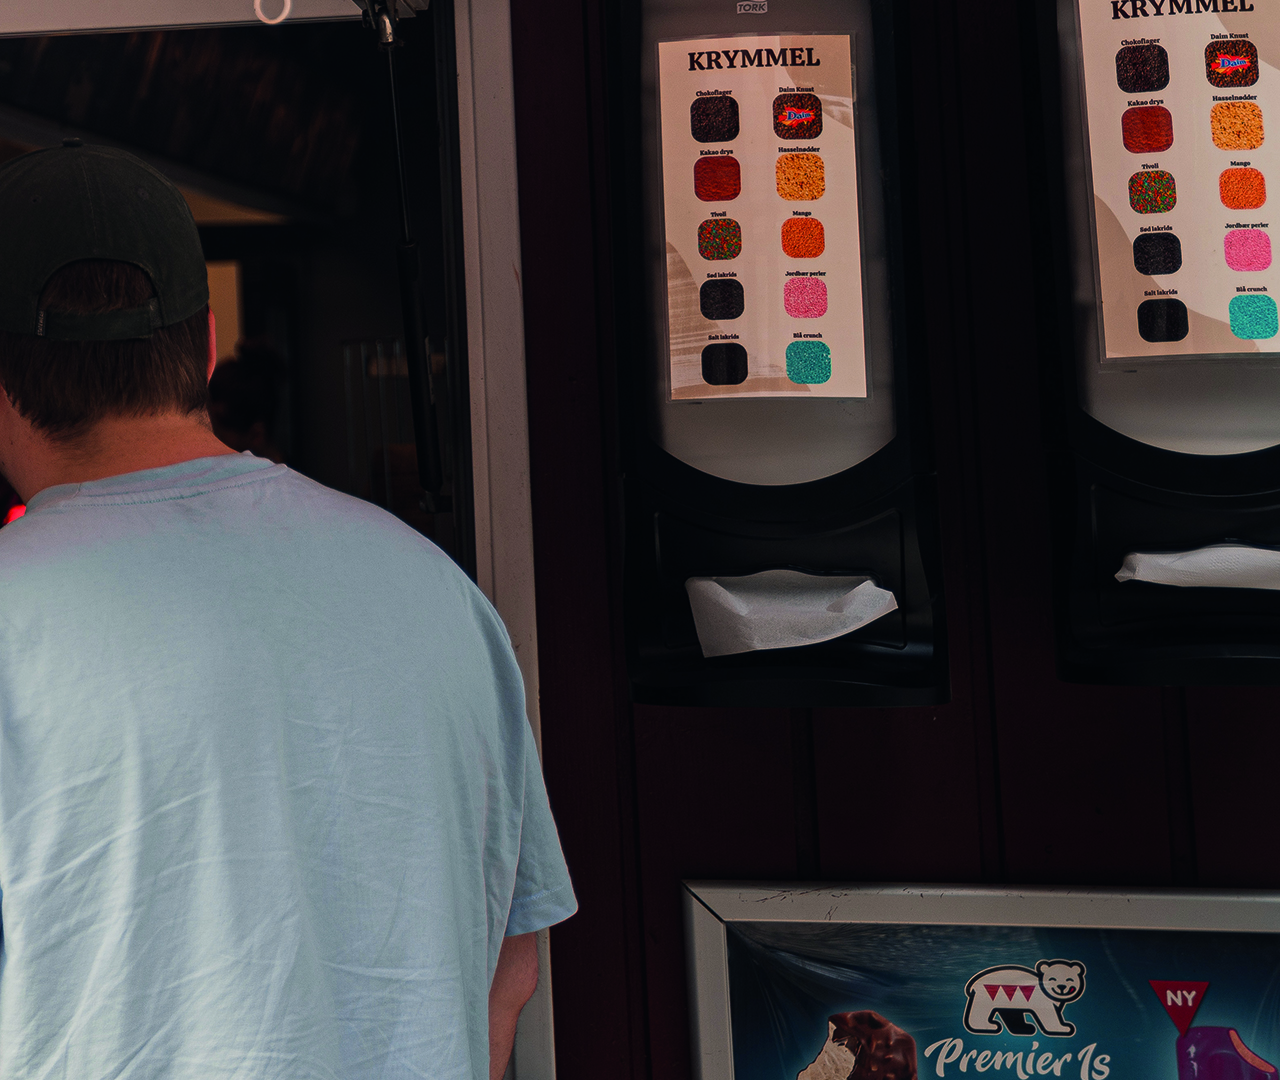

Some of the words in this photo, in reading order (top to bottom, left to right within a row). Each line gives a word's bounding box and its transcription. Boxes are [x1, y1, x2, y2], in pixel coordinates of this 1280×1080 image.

[738, 2, 766, 12] TORK
[687, 47, 821, 71] KRYMMEL
[1220, 58, 1247, 69] Daim
[1212, 94, 1258, 102] Hasselnødder
[1149, 99, 1165, 107] drys
[719, 148, 734, 156] drys
[1230, 160, 1252, 168] Mango
[792, 210, 813, 218] Mango
[1143, 289, 1156, 297] Salt
[1156, 288, 1178, 296] lakrids
[1236, 285, 1246, 293] Blå
[1246, 285, 1268, 293] crunch
[802, 331, 823, 339] crunch
[1166, 989, 1197, 1007] NY
[924, 1037, 1073, 1080] Premier
[1076, 1042, 1111, 1080] Is
